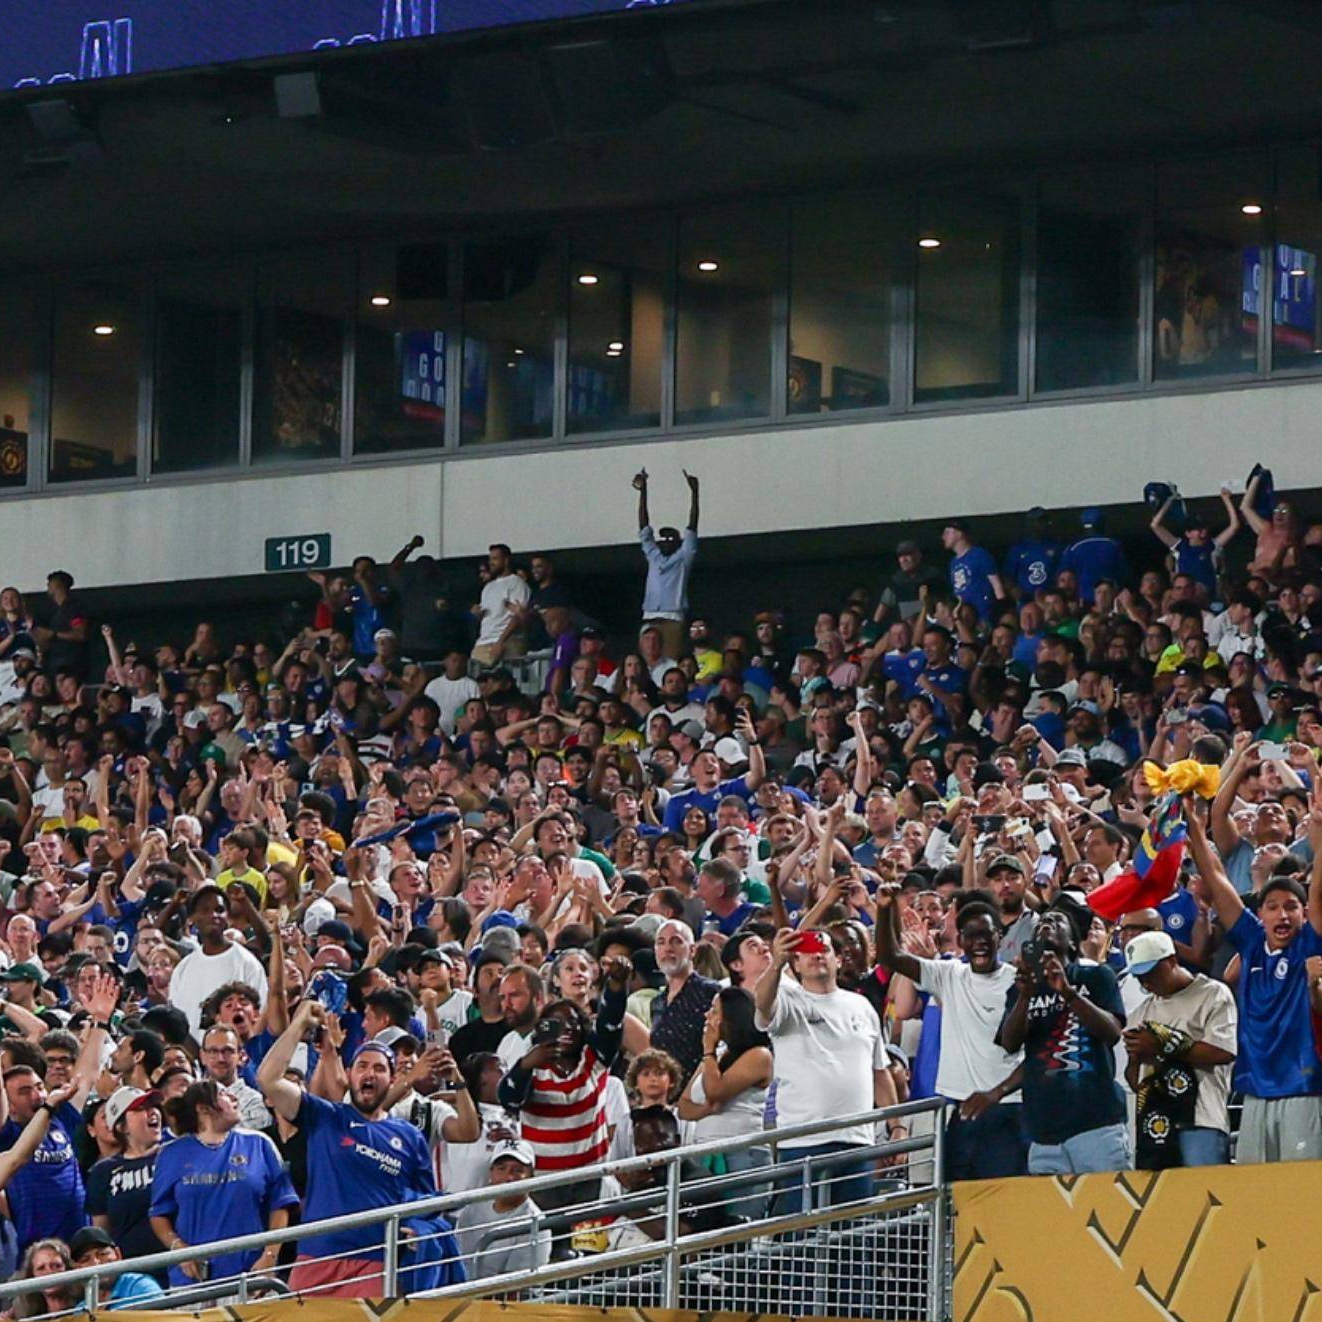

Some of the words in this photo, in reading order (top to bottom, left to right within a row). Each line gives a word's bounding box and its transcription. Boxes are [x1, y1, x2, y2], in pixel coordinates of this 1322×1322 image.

[275, 538, 320, 567] 119
[355, 1143, 402, 1169] YOKOHAMA
[109, 1167, 158, 1197] PHIL
